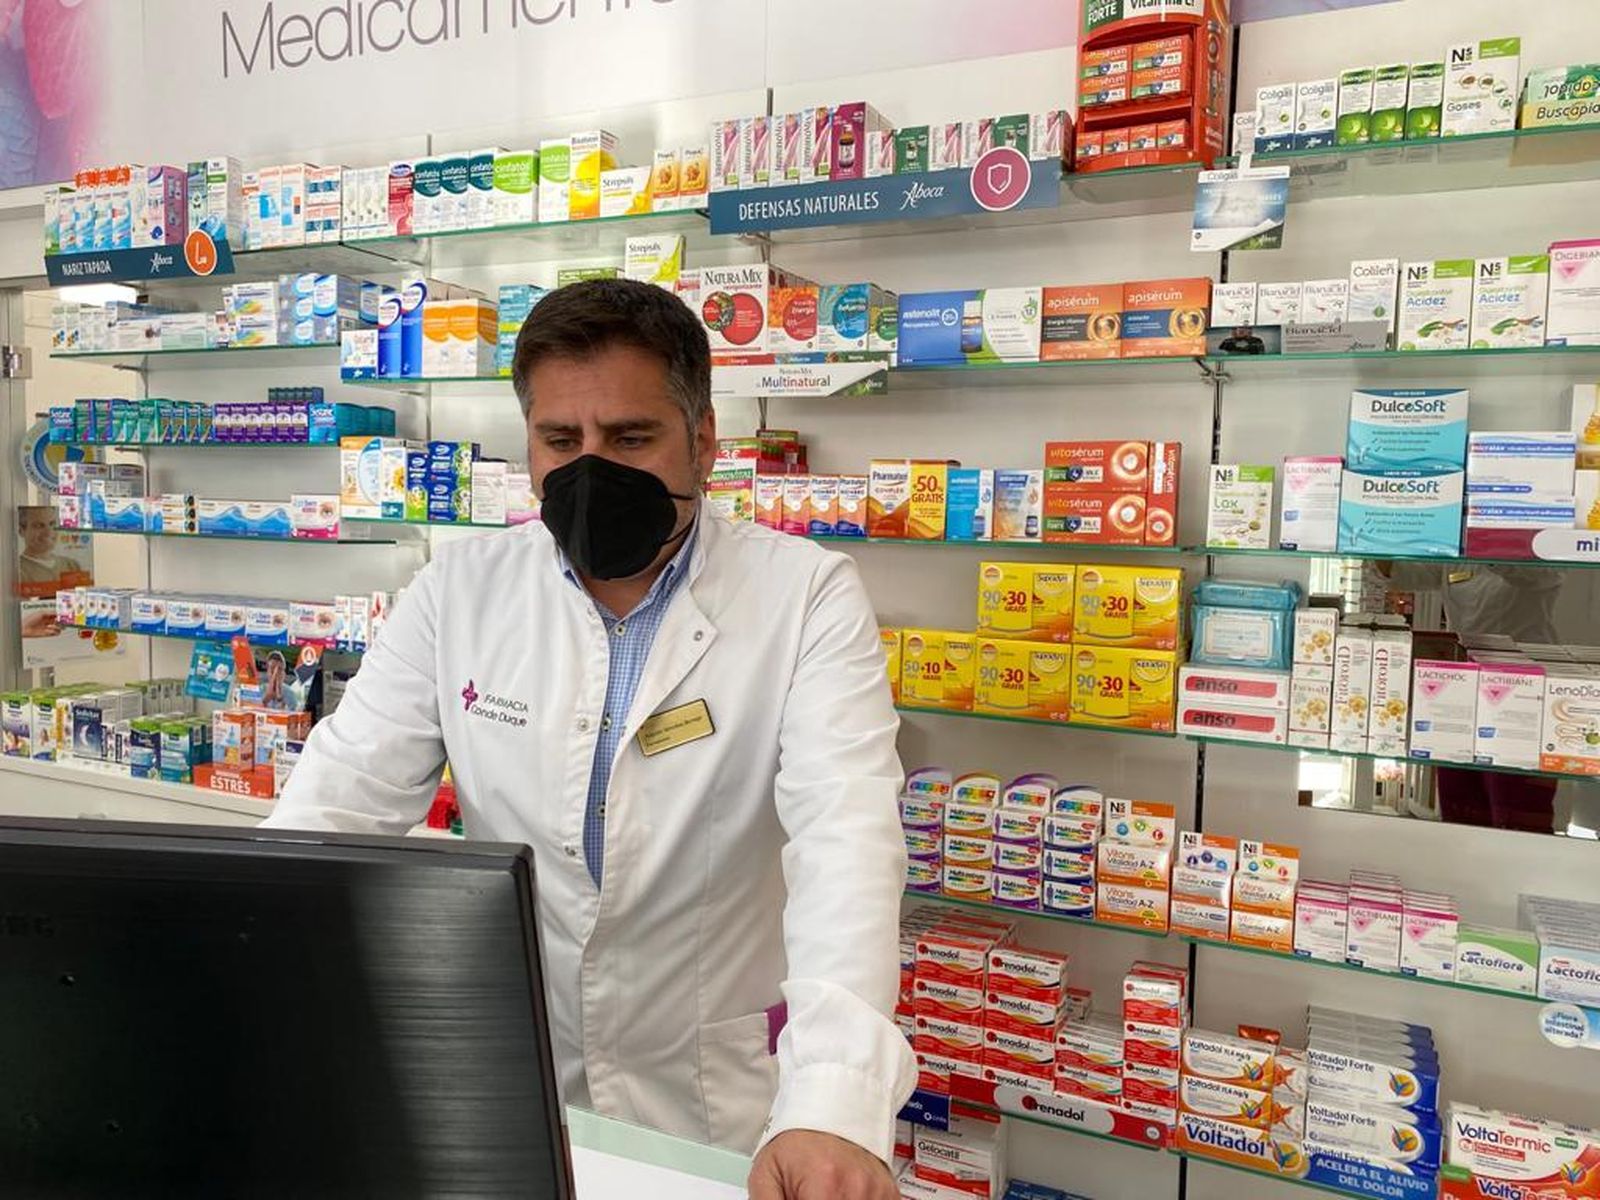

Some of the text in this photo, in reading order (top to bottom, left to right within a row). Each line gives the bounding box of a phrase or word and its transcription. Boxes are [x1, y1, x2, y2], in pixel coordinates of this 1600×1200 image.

[1087, 4, 1118, 25] FORTE
[738, 192, 880, 221] DEFENSAS NATURALES
[1478, 292, 1521, 303] Acidez
[761, 375, 831, 389] Multinatural
[1371, 399, 1447, 413] DulceSoft
[1362, 479, 1440, 494] DulceSoft
[911, 492, 945, 504] GRATIS
[1213, 495, 1239, 509] Lax
[1194, 677, 1239, 693] anso
[484, 694, 529, 713] FARMACIA
[1192, 711, 1237, 727] anso
[1139, 860, 1155, 869] A-Z
[1138, 900, 1154, 909] A-Z
[1189, 1039, 1223, 1055] Voltadol
[1307, 1050, 1375, 1073] Voltadol Forte
[1186, 1077, 1220, 1092] Voltadol
[1308, 1104, 1377, 1128] Voltadol Forte
[1186, 1123, 1265, 1156] Voltadol
[1456, 1121, 1552, 1154] VoltaTermic
[1315, 1157, 1429, 1193] ACELERA EL ALIVIO
[1338, 1173, 1404, 1198] DEL DOLOR
